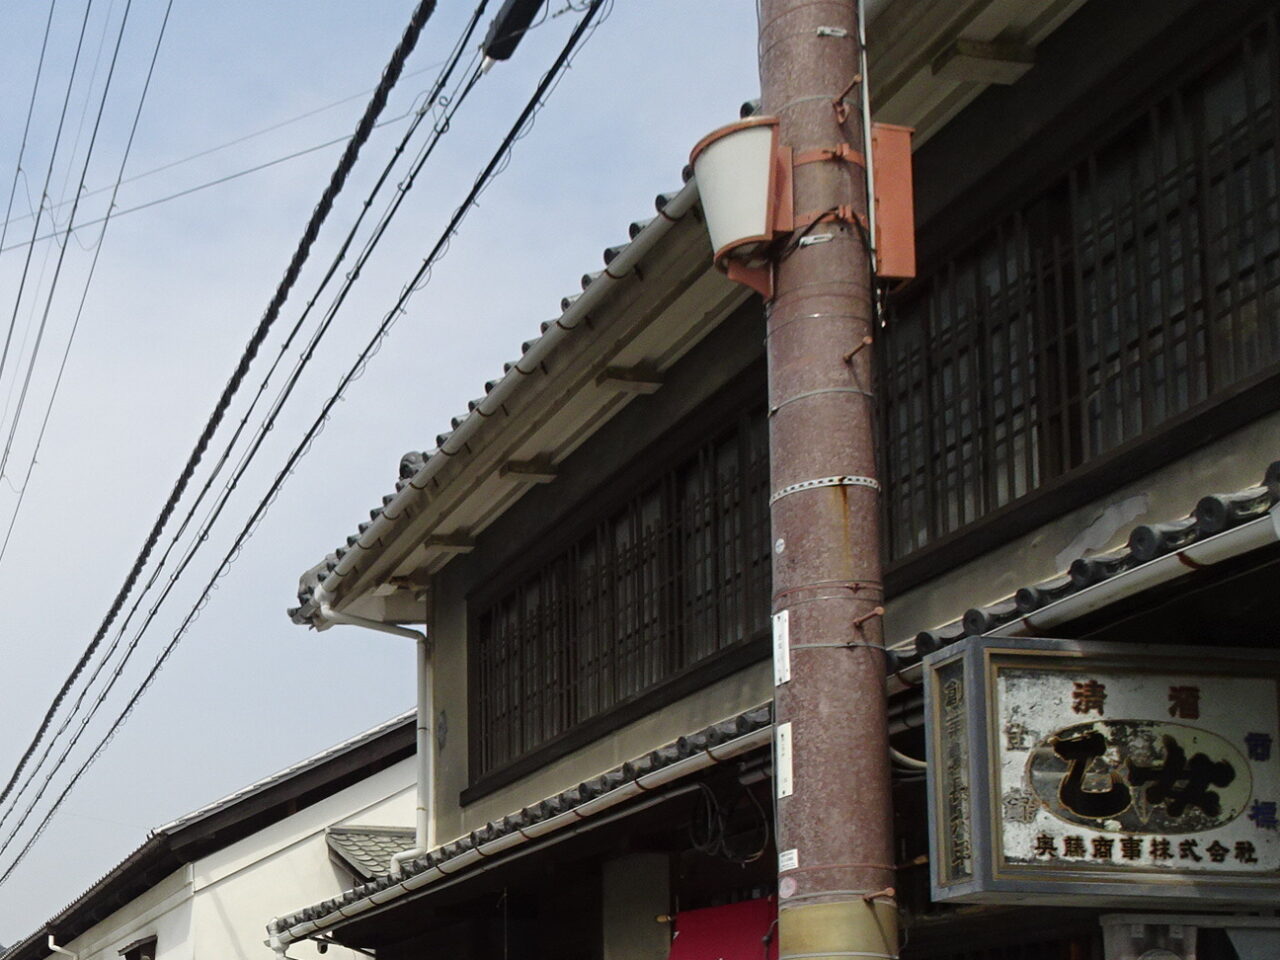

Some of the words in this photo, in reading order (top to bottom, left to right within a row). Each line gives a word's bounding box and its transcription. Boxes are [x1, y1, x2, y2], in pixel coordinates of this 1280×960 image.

[1072, 680, 1200, 720] 清酒
[1033, 834, 1259, 865] 奥藤商事株式会社
